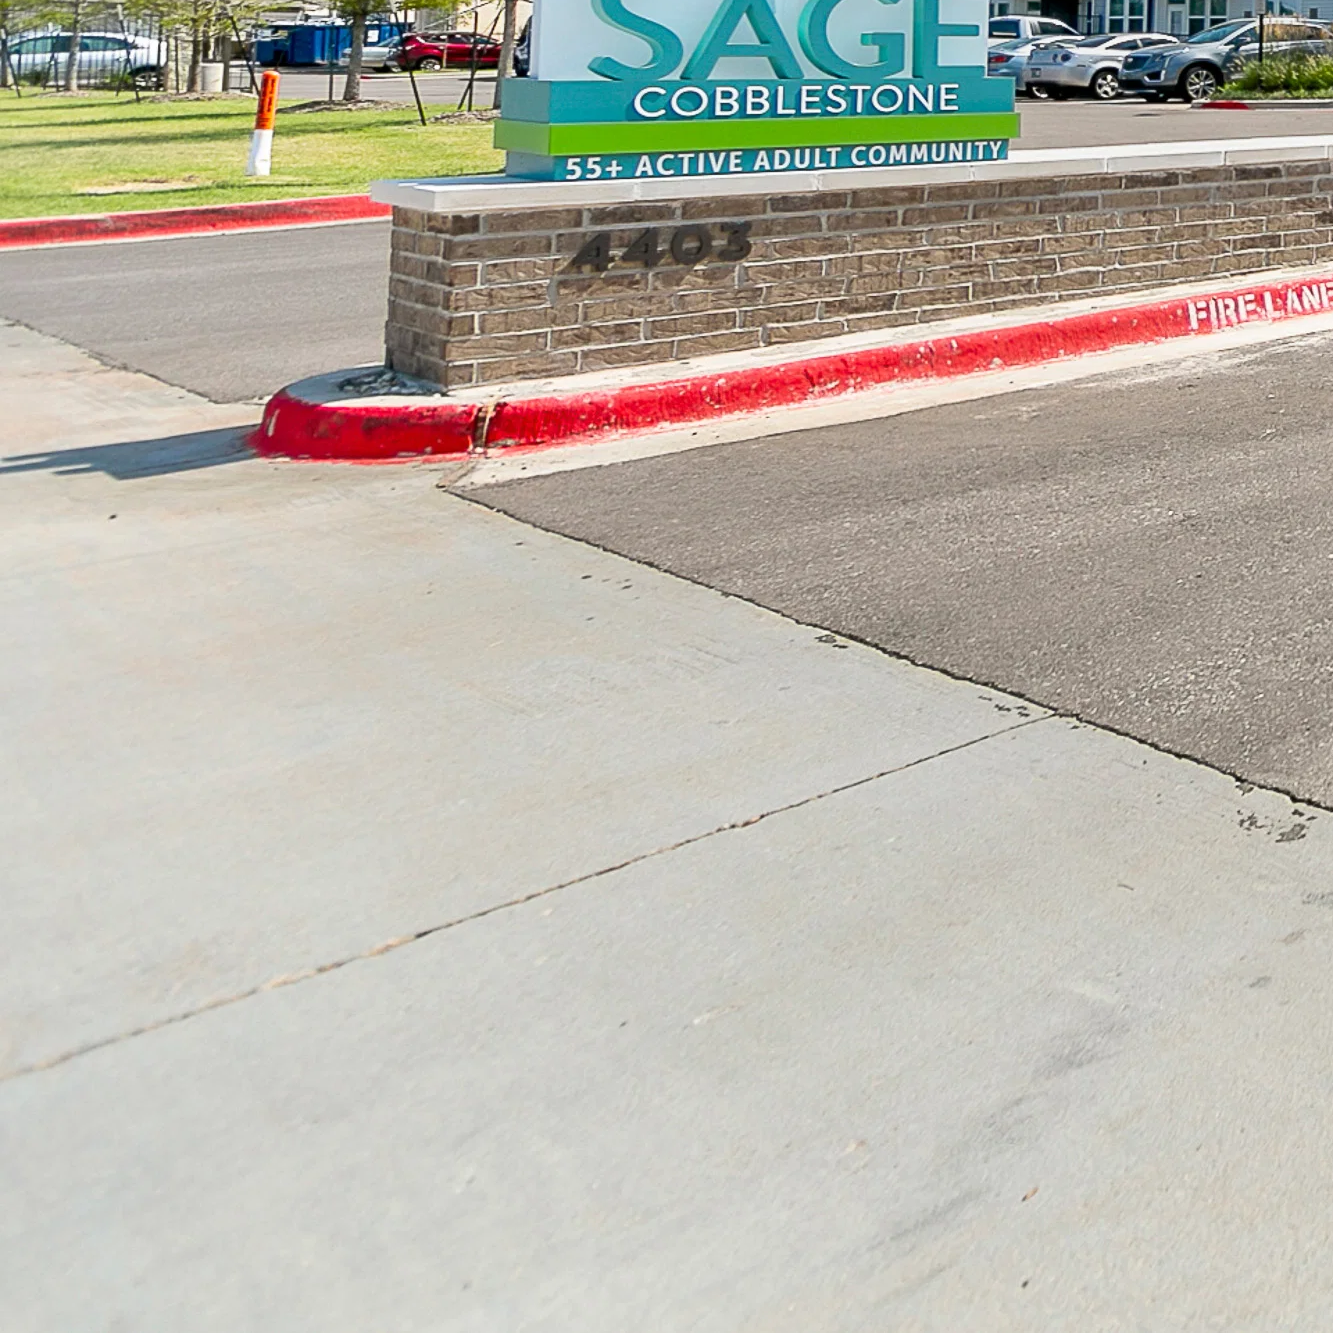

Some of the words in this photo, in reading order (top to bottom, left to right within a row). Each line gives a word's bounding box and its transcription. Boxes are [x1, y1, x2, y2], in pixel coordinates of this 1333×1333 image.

[633, 84, 960, 119] COBBLESTONE
[565, 157, 623, 179] 55+
[634, 150, 742, 177] ACTIVE
[753, 146, 842, 171] ADULT
[850, 141, 1003, 166] COMMUNITY
[565, 220, 753, 273] 4403
[1187, 292, 1258, 331] FIRE
